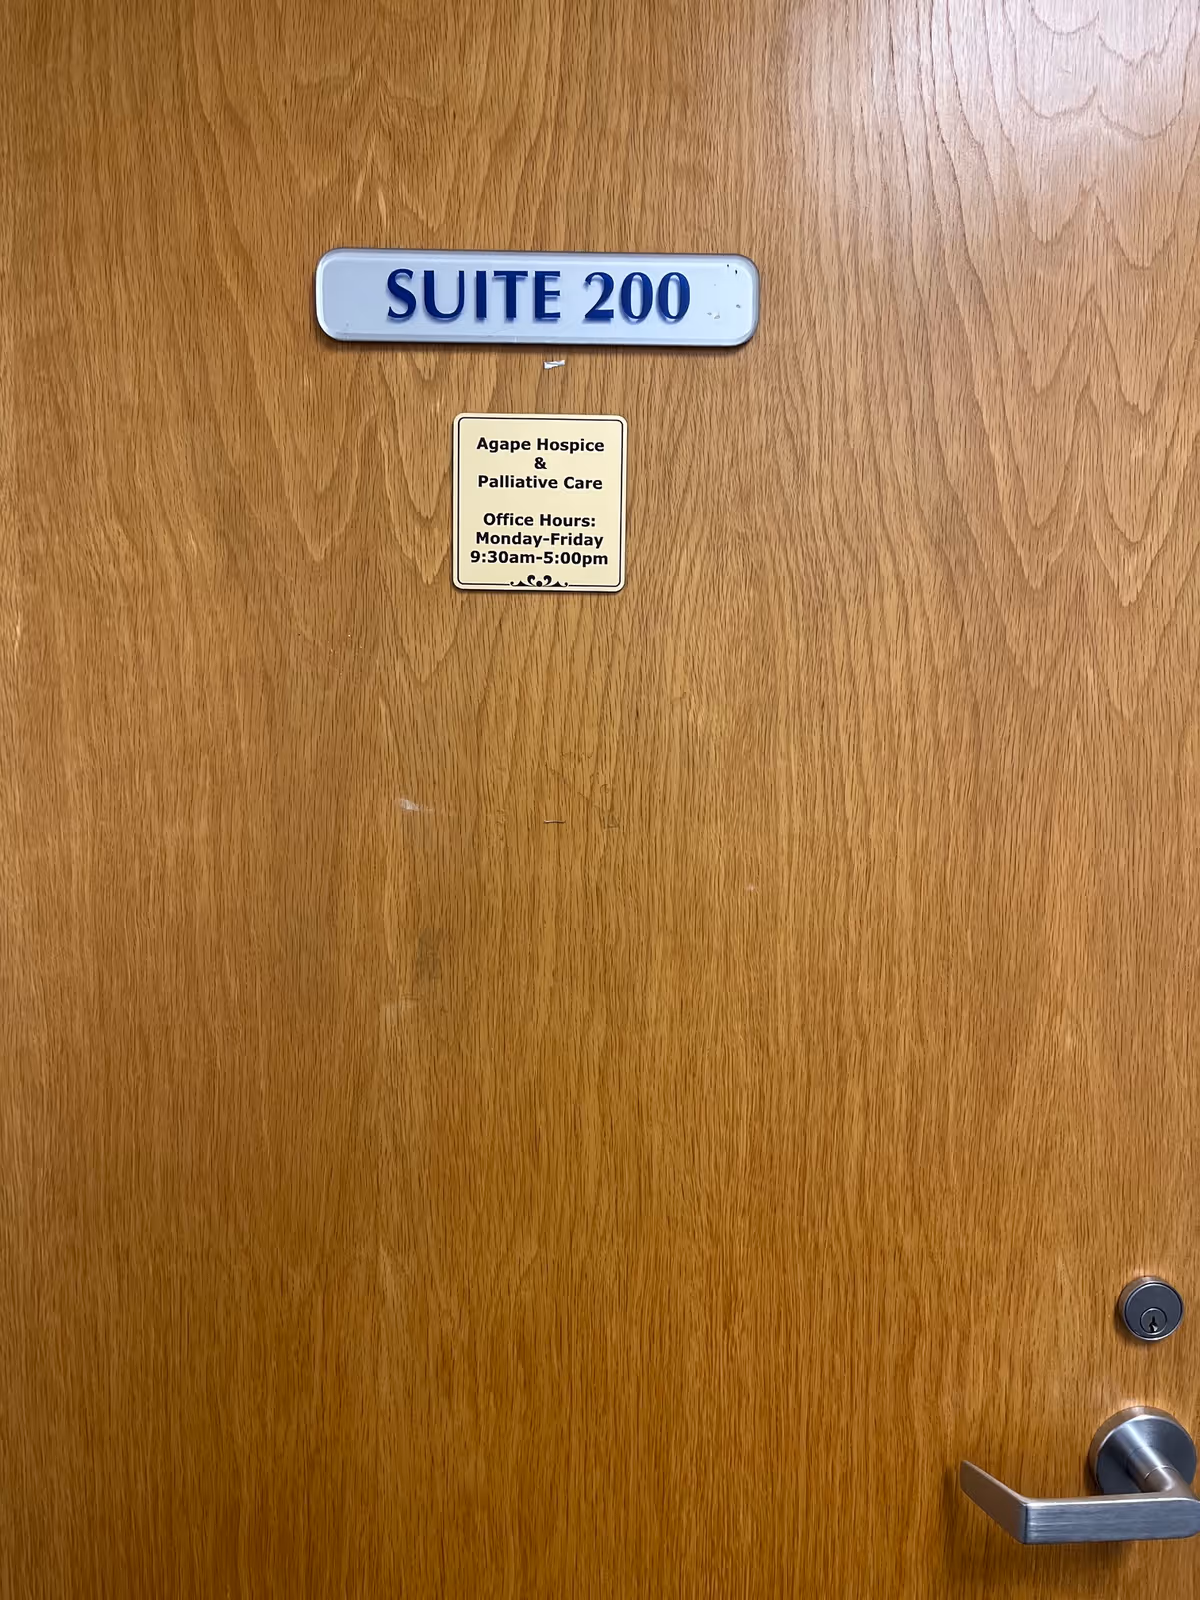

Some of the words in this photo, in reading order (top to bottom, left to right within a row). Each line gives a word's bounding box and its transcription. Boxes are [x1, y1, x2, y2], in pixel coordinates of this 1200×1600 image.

[386, 268, 561, 321] SUITE
[584, 271, 691, 322] 200
[476, 437, 531, 453] Agape
[537, 438, 605, 454] Hospice
[534, 457, 547, 469] &
[478, 475, 558, 489] Palliative
[563, 476, 603, 490] Care
[483, 513, 534, 526] Office
[540, 514, 596, 527] Hours:
[476, 532, 604, 549] Monday-Friday
[470, 550, 608, 567] 9:30am-5:00pm
